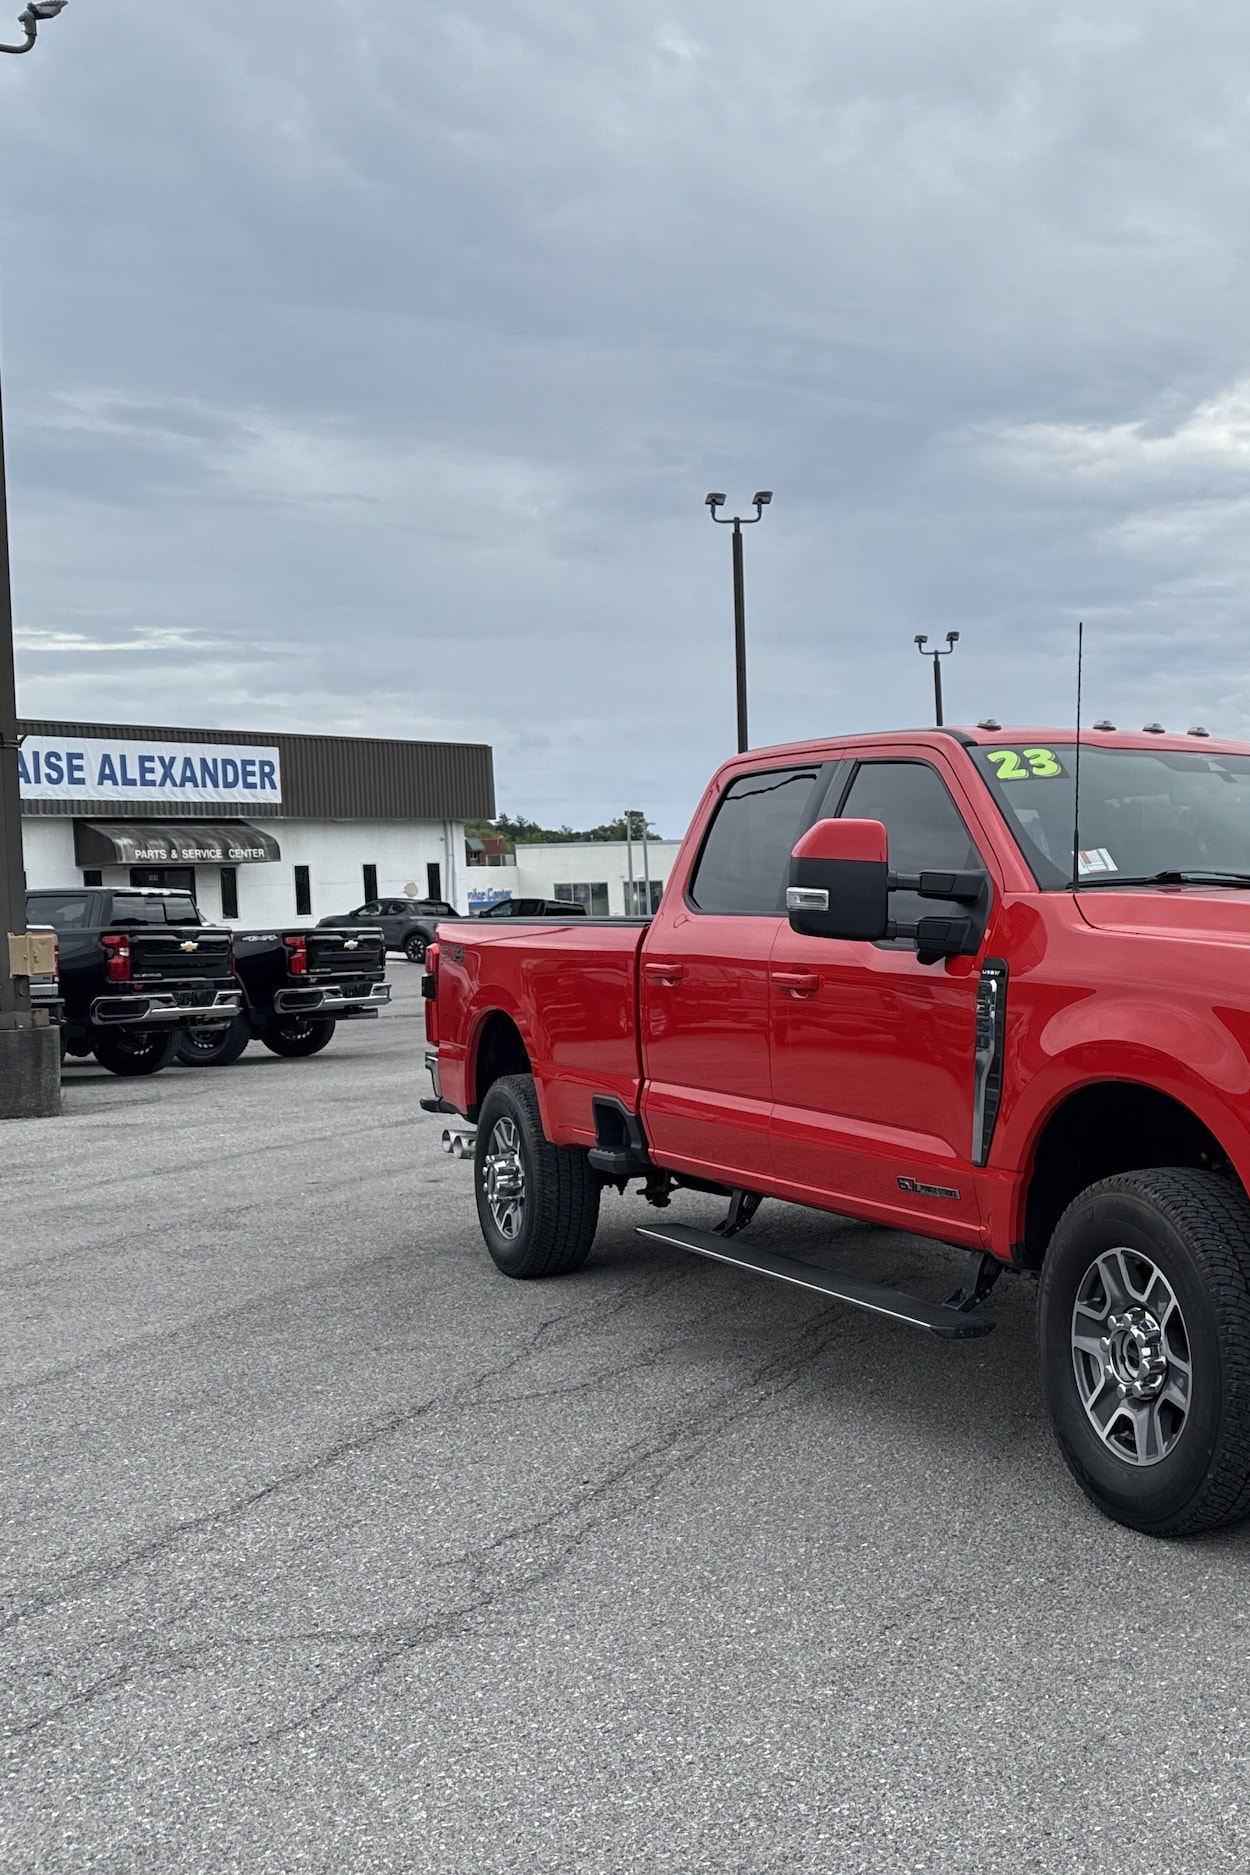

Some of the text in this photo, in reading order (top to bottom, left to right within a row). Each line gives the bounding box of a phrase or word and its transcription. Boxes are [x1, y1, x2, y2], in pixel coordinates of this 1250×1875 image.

[18, 750, 277, 790] AISE ALEXANDER
[987, 748, 1062, 779] 23
[135, 848, 265, 860] PARTS & SERVICE CENTER
